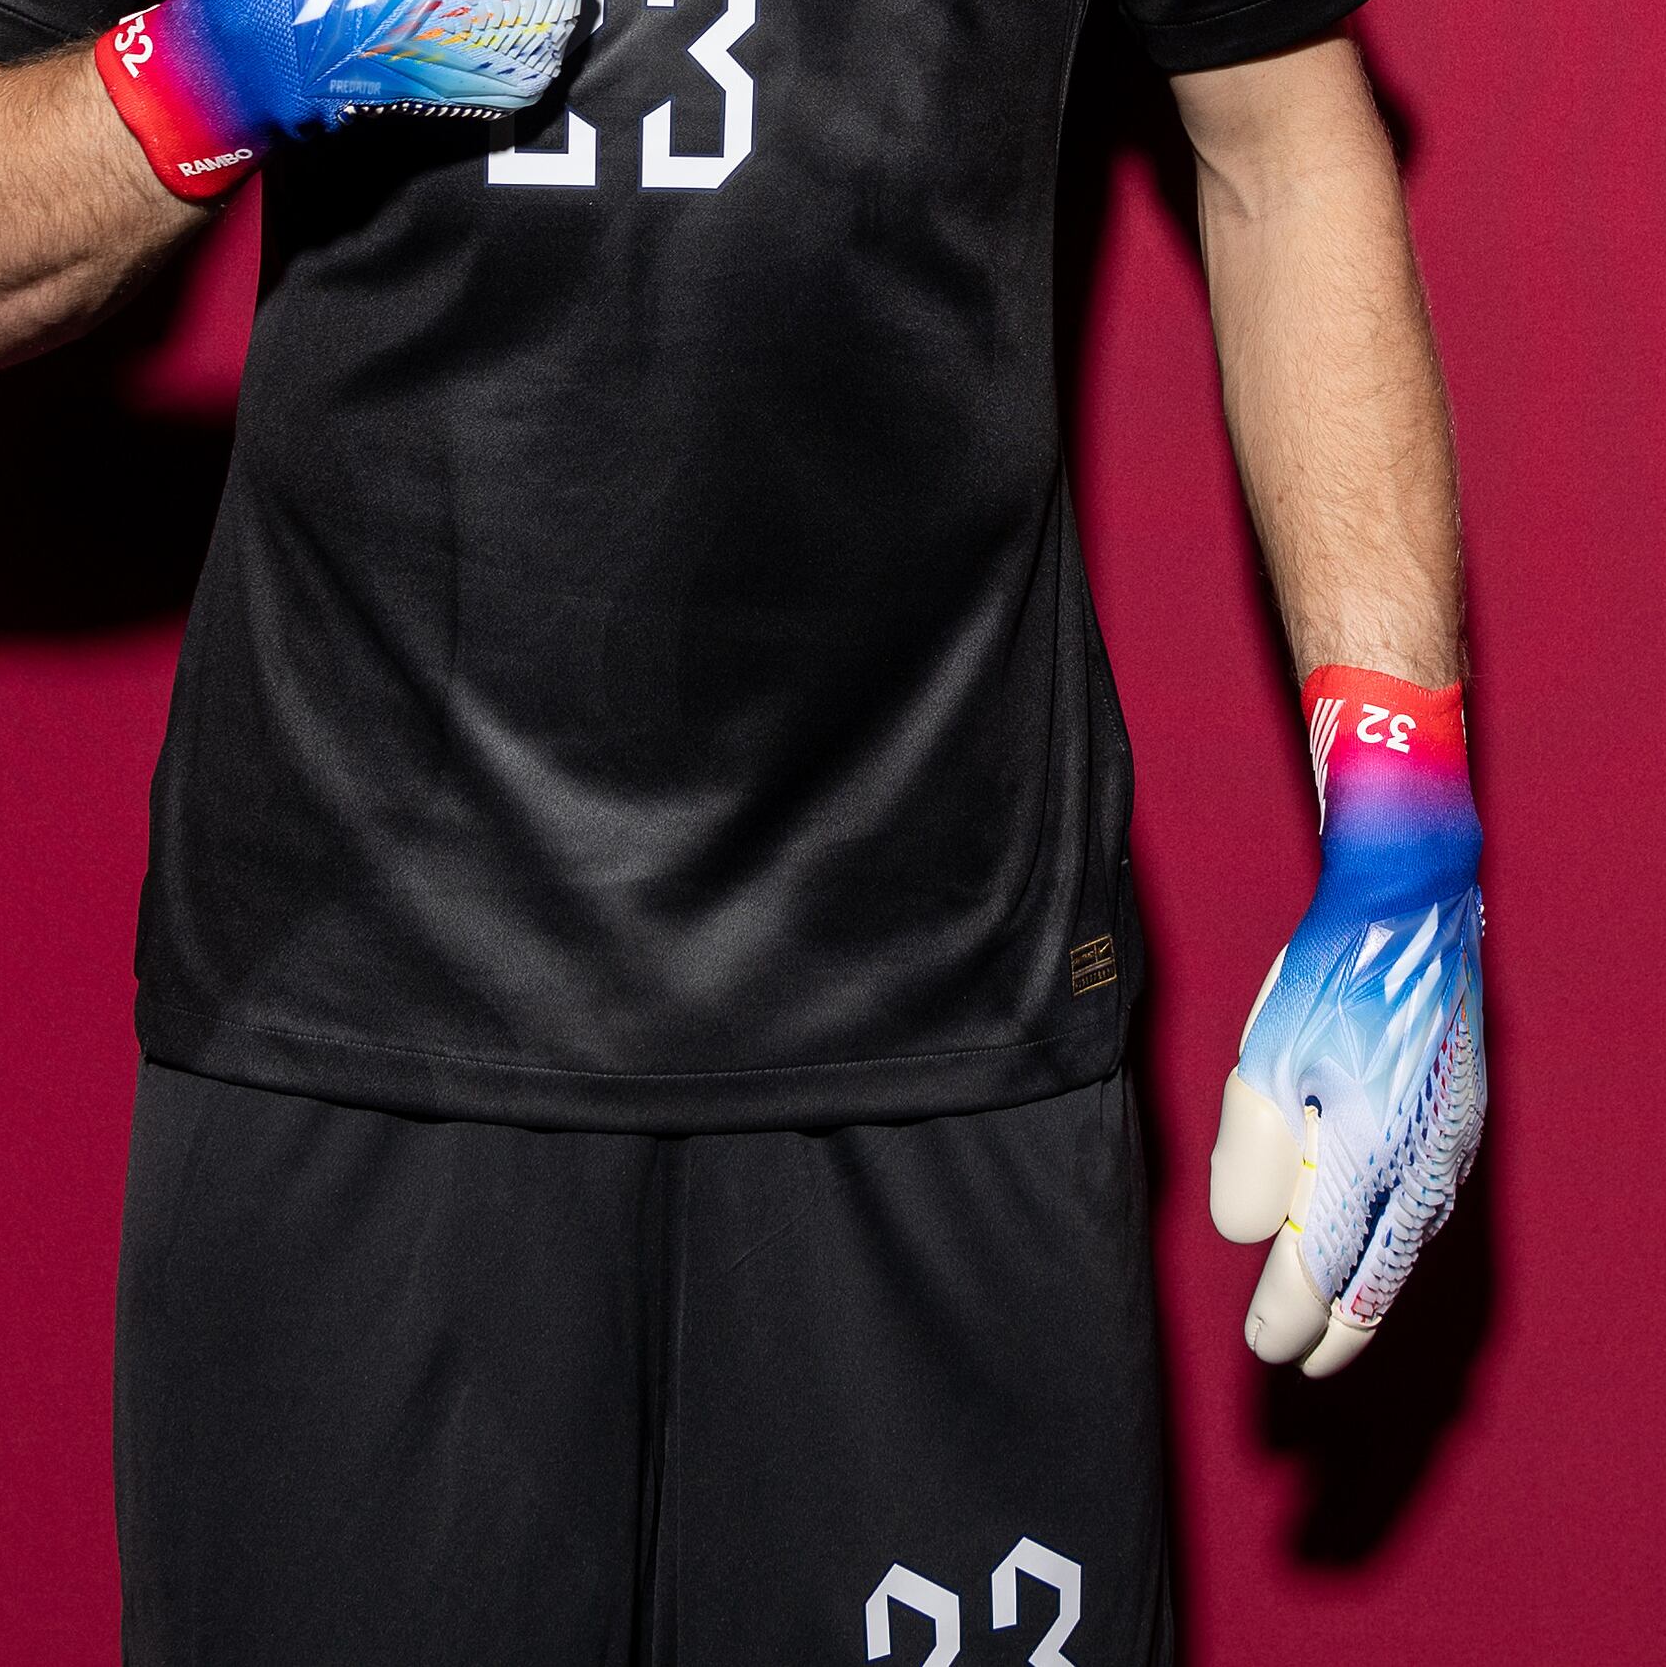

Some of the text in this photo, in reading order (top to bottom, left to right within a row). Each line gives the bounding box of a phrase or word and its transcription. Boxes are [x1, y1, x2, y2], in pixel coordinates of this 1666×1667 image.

[114, 15, 153, 78] 32
[329, 79, 382, 95] PREDATOR
[178, 148, 254, 177] RAMBO
[1356, 702, 1417, 754] 32
